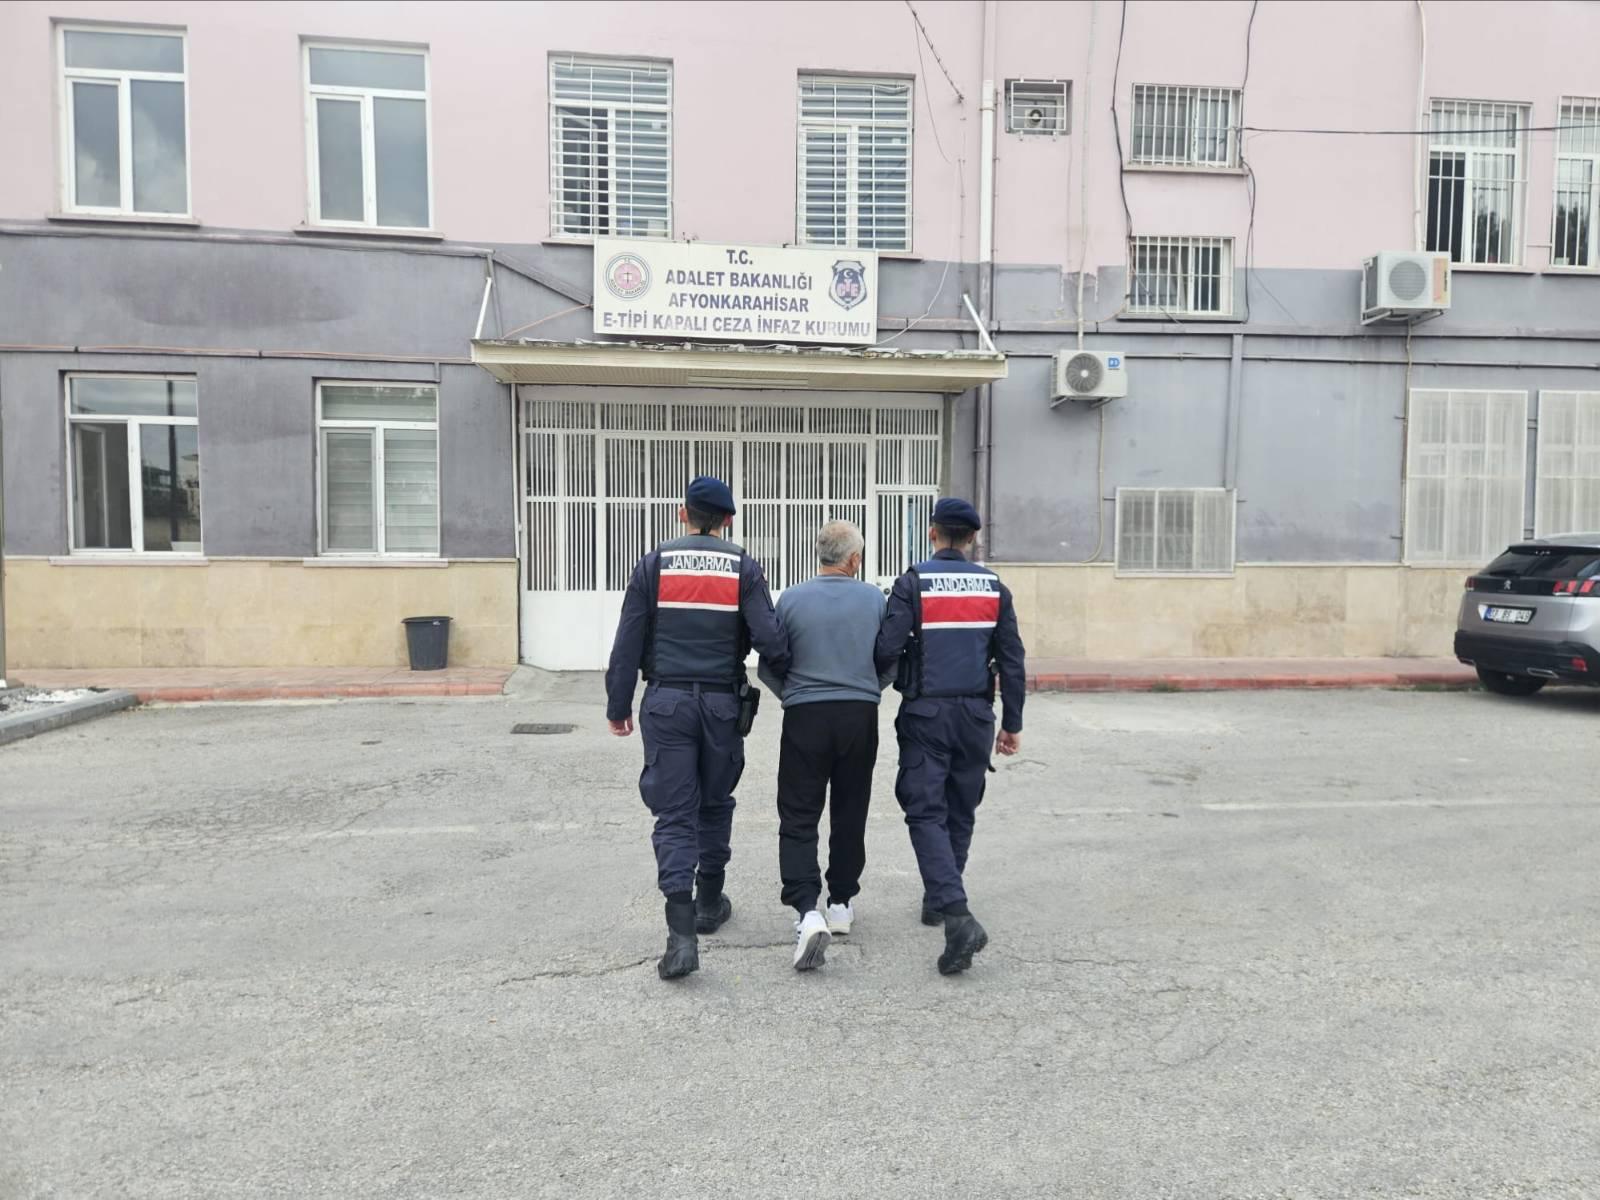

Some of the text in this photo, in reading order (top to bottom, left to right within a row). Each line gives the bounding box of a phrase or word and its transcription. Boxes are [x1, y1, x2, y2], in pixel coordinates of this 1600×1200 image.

[726, 249, 753, 265] T.C.
[665, 269, 812, 290] ADALET BAKANLIĞI
[668, 292, 809, 313] AFYONKARAHİSAR
[603, 309, 871, 337] E-TİPİ KAPALI CEZA İNFAZ KURUMU
[668, 555, 733, 573] JANDARMA
[928, 577, 993, 593] JANDARMA
